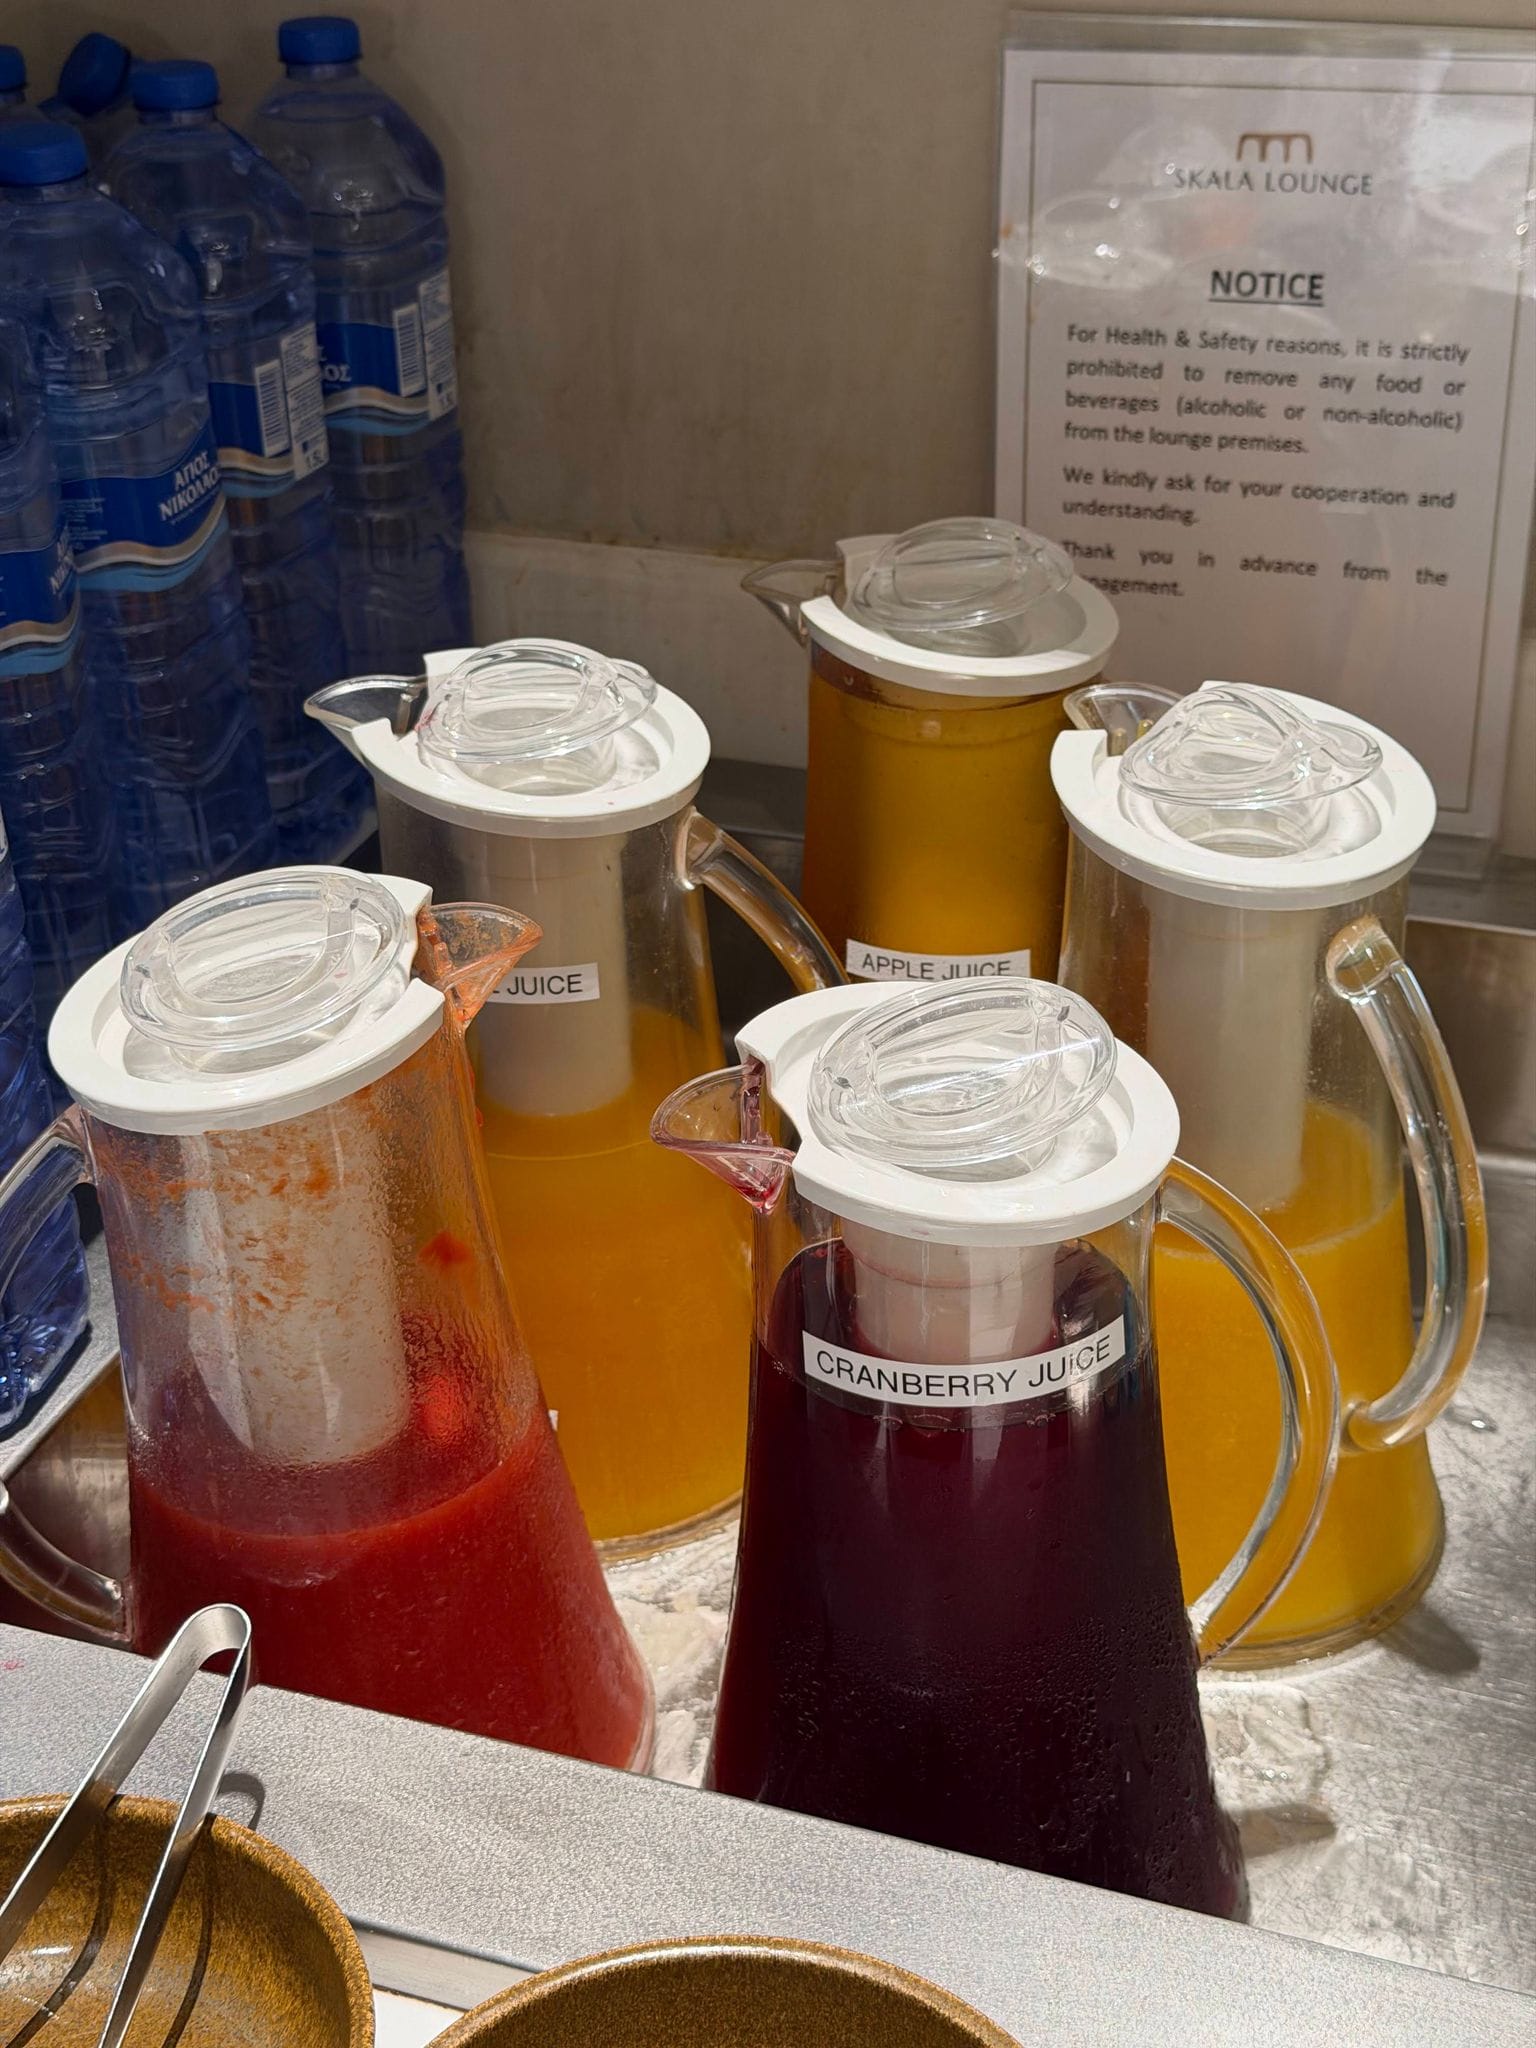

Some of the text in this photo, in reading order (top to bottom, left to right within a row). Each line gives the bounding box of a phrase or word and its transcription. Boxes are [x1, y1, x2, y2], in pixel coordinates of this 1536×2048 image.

[1174, 168, 1373, 196] SKALA LOUNGE
[1210, 269, 1325, 301] NOTICE
[1067, 324, 1470, 366] For Health & Safety reasons, it is strictly
[1066, 359, 1466, 396] prohibited to remove any food or
[1065, 390, 1464, 433] beverages (alcoholic or non-alcoholic)
[1064, 421, 1308, 454] from the lounge premises.
[1063, 466, 1456, 509] We kindly ask for your cooperation and
[1063, 500, 1199, 527] understanding.
[1062, 540, 1448, 587] Thank you in advance from the
[861, 952, 1012, 981] APPLE JUICE
[507, 973, 584, 996] JUICE
[817, 1350, 1018, 1398] CRANBERRY
